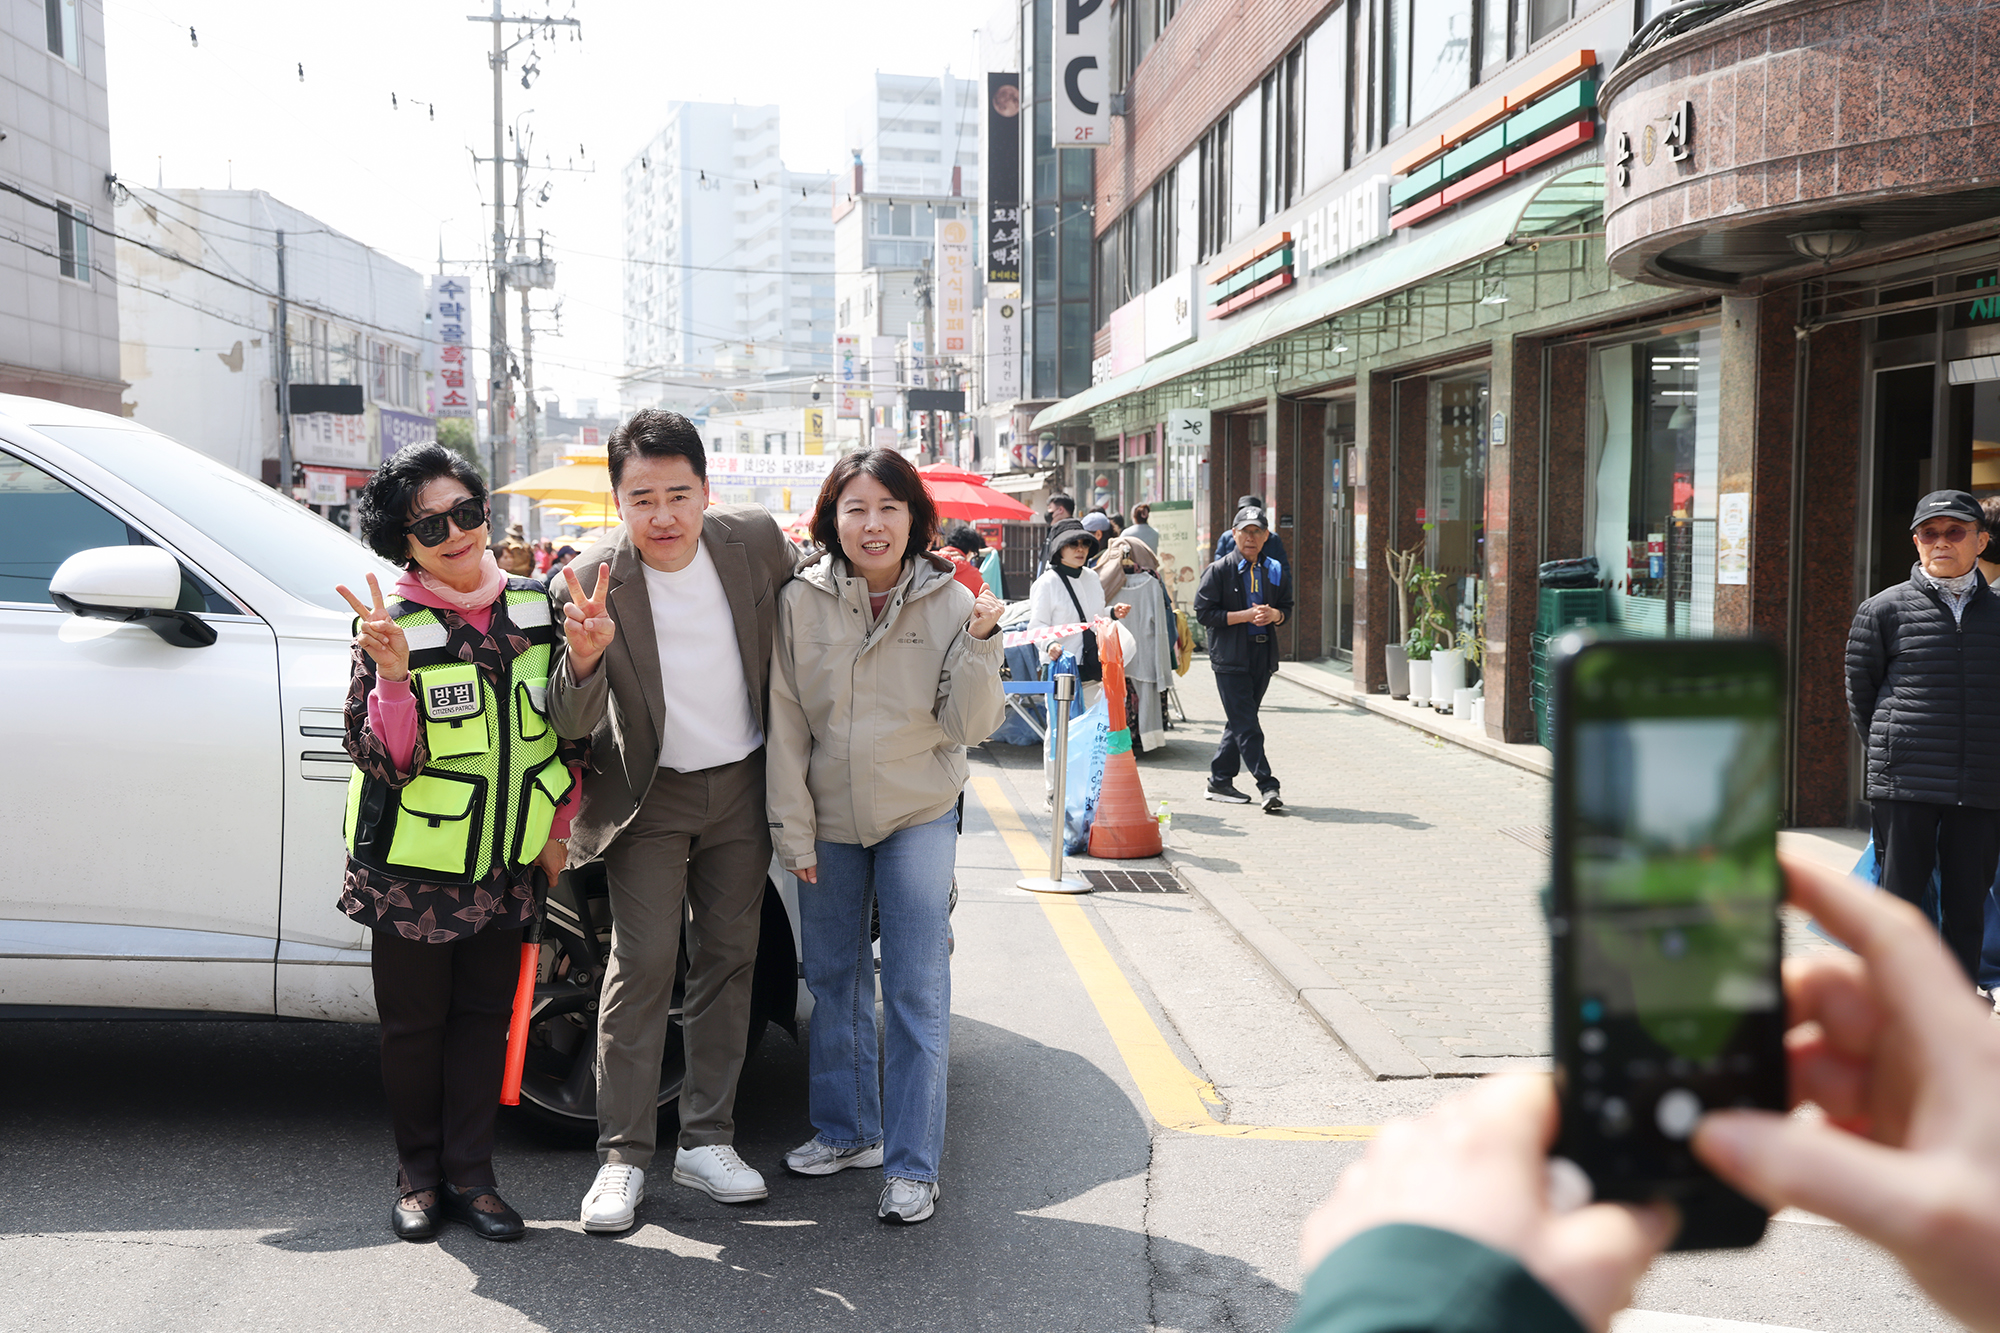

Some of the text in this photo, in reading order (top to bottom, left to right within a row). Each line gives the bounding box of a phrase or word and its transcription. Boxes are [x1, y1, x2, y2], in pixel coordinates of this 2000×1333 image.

[1074, 127, 1094, 140] 2F
[696, 177, 720, 191] 104
[992, 228, 1020, 245] 소주
[992, 248, 1020, 266] 맥주
[946, 255, 964, 331] 한식뷔페
[438, 279, 467, 406] 수락골흑염소
[434, 685, 470, 706] 방범
[432, 704, 475, 716] CITIZENS PATROL
